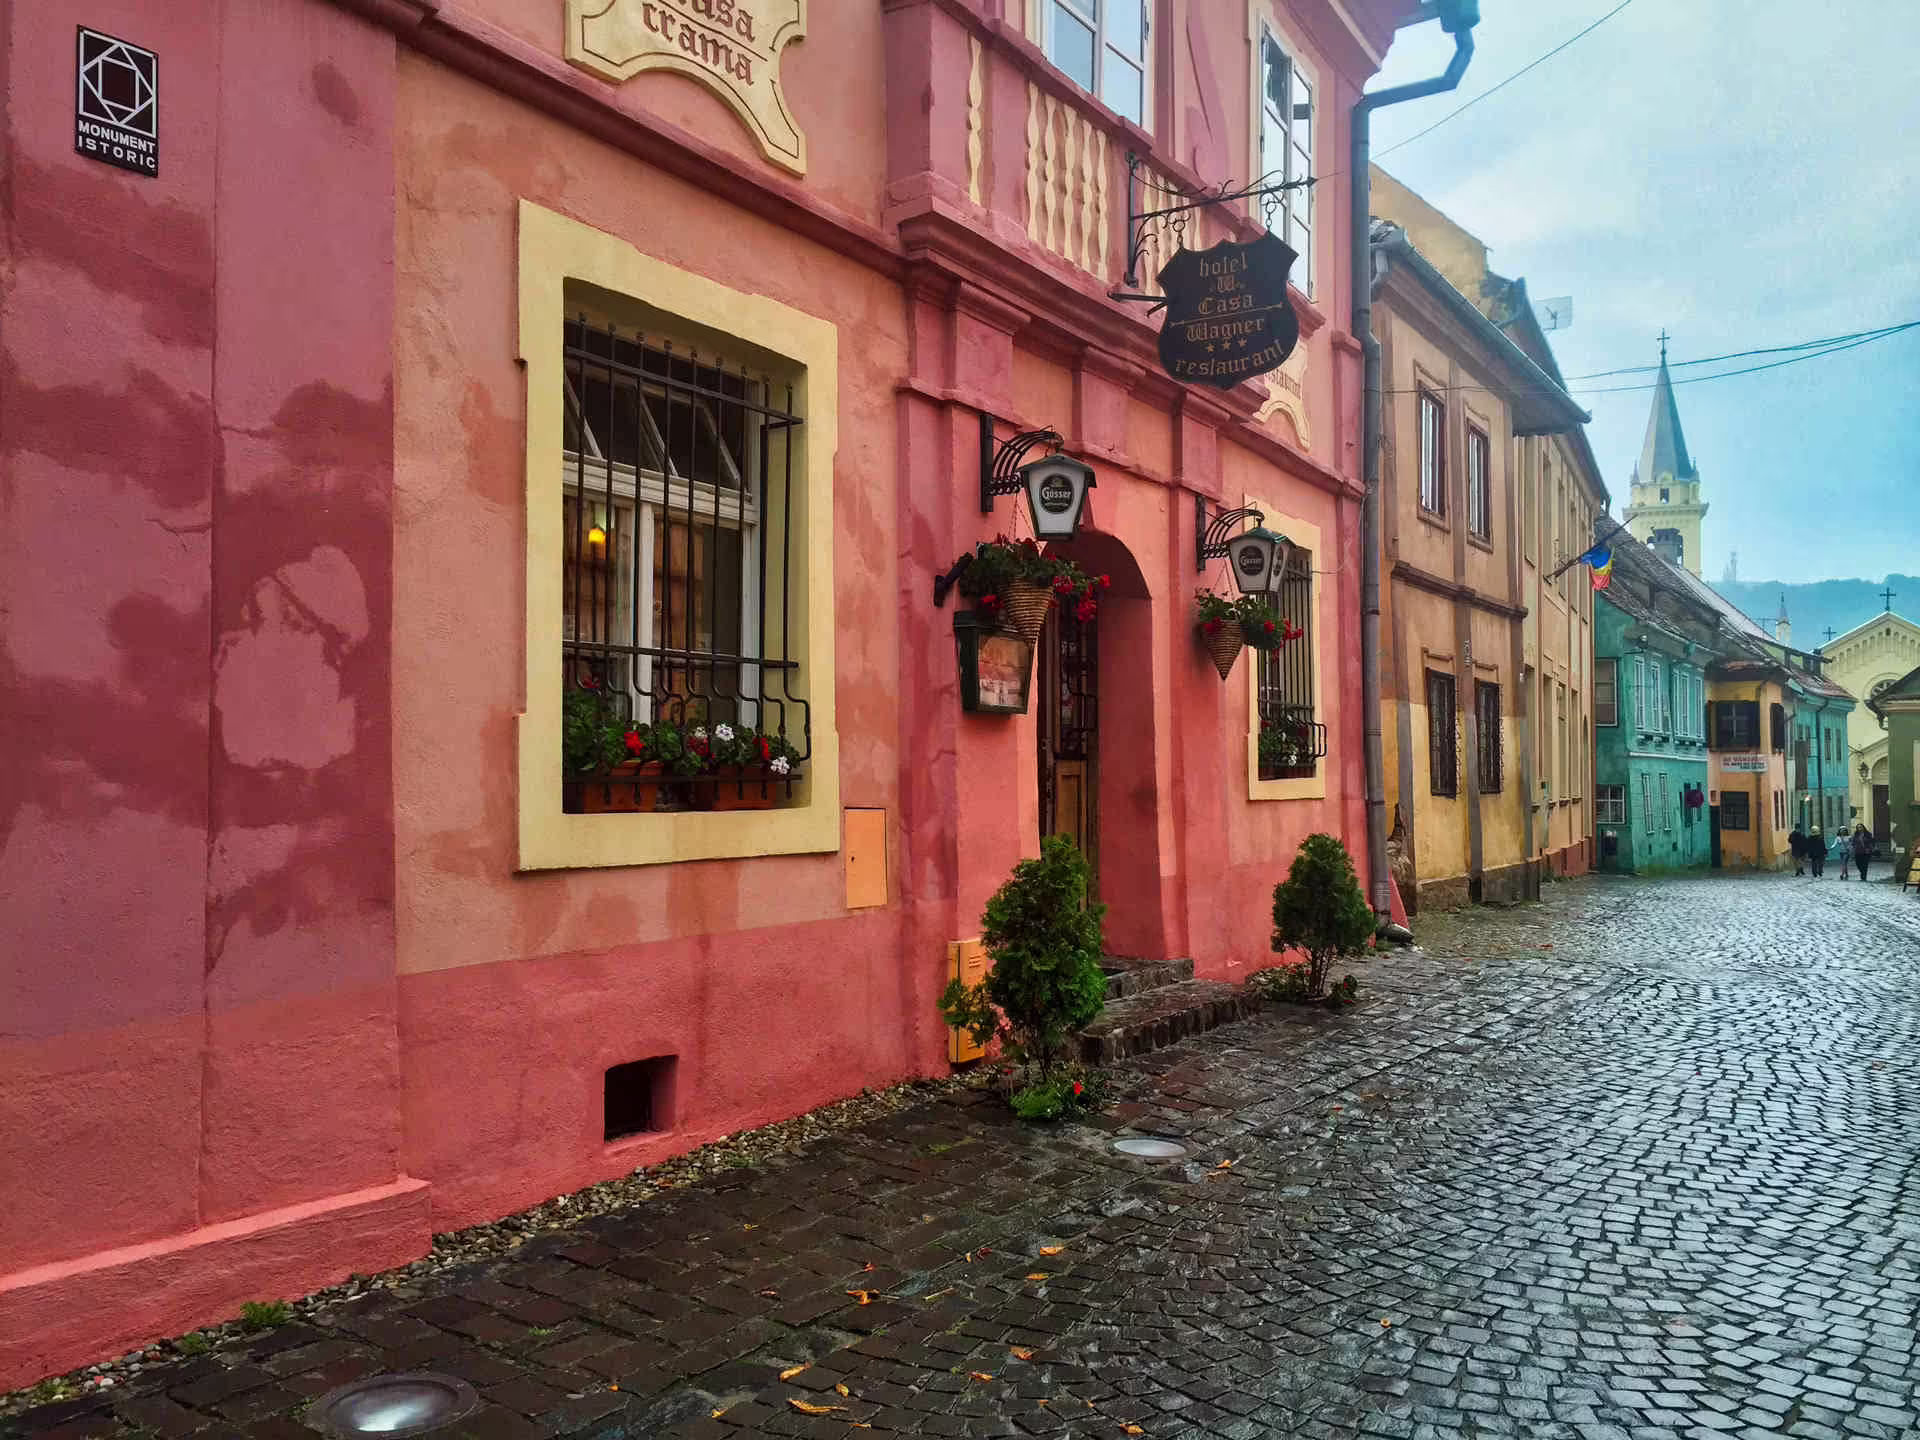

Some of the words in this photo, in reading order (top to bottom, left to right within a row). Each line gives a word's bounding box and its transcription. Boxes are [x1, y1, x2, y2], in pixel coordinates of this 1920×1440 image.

[642, 3, 754, 86] crama
[78, 119, 156, 154] MONUMENT
[78, 135, 156, 168] ISTORIC
[1199, 251, 1248, 277] hotel
[1198, 294, 1253, 314] Casa
[1186, 318, 1264, 342] Wagner
[1175, 338, 1285, 376] restaurant
